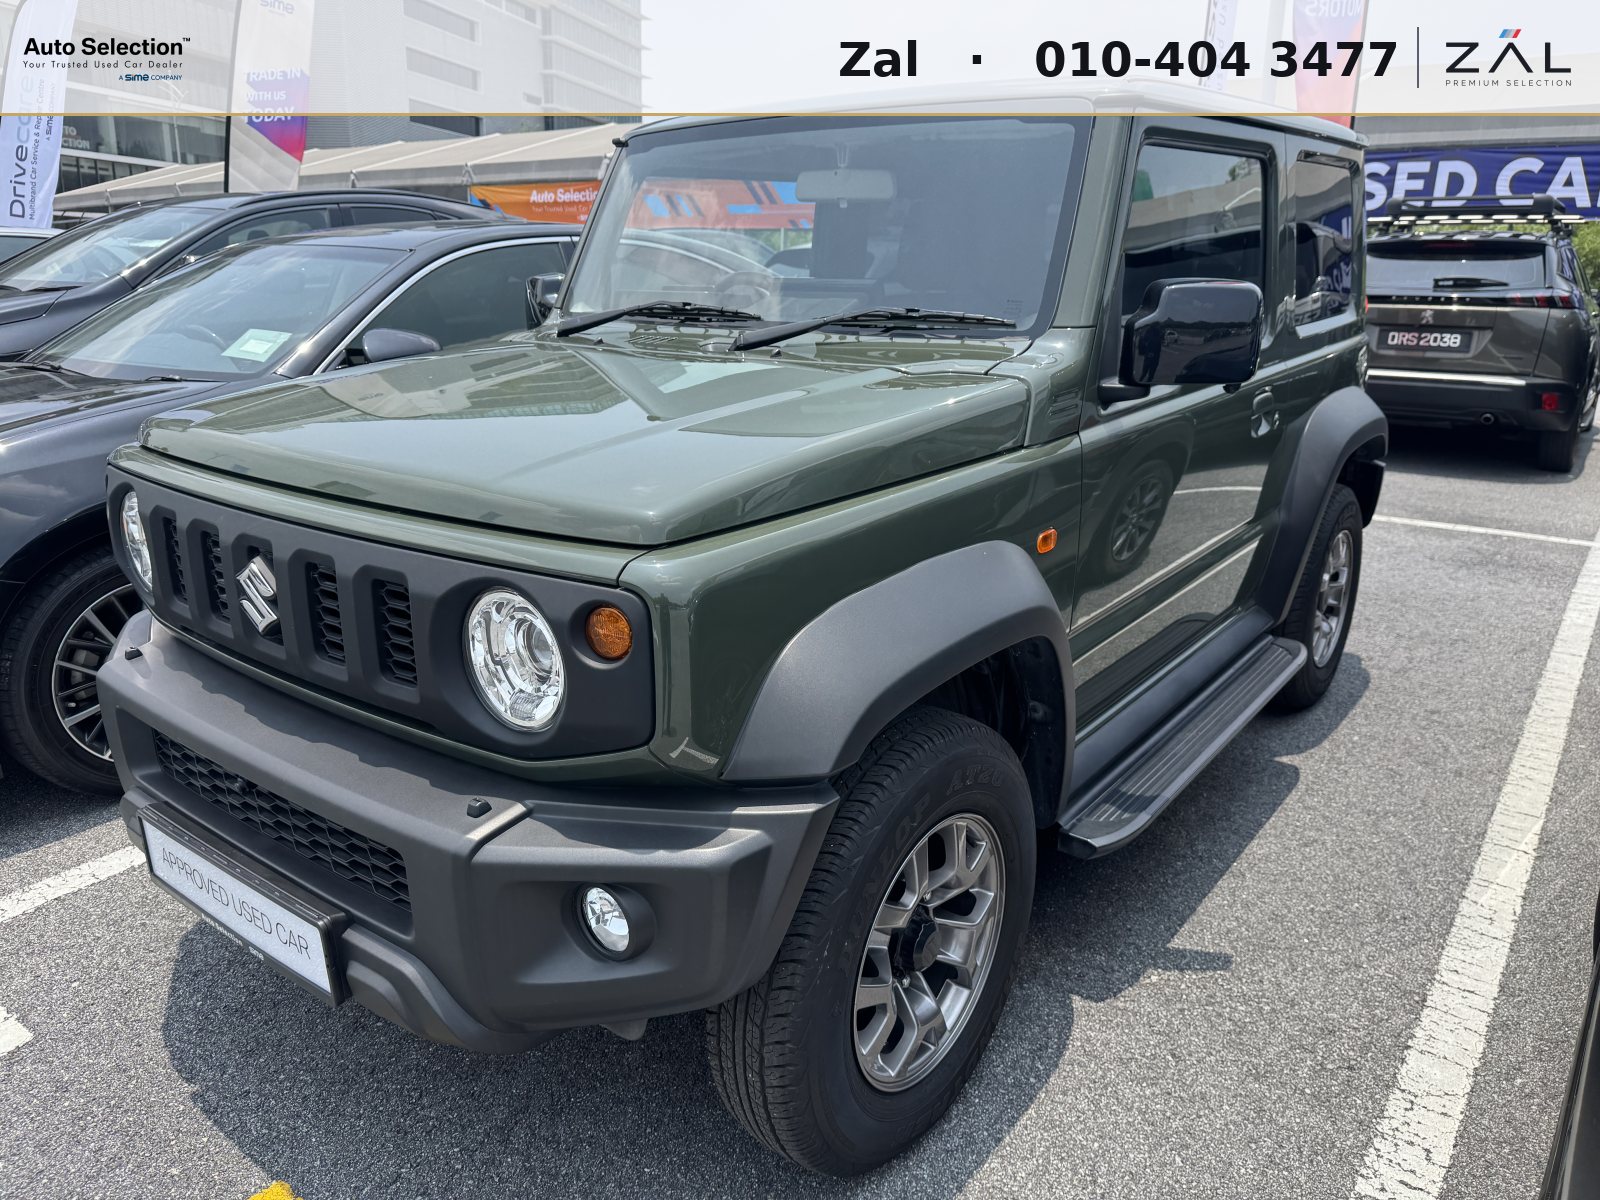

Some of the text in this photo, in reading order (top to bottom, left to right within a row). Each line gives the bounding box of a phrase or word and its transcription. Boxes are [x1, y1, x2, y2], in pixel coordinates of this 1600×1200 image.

[287, 68, 301, 79] IN
[273, 90, 287, 100] US
[31, 138, 40, 165] Service
[1364, 156, 1600, 211] SED CA
[29, 181, 37, 220] Multibrand
[530, 190, 554, 203] Auto
[1420, 332, 1461, 348] 2038
[162, 847, 311, 960] APPROVED USED CAR
